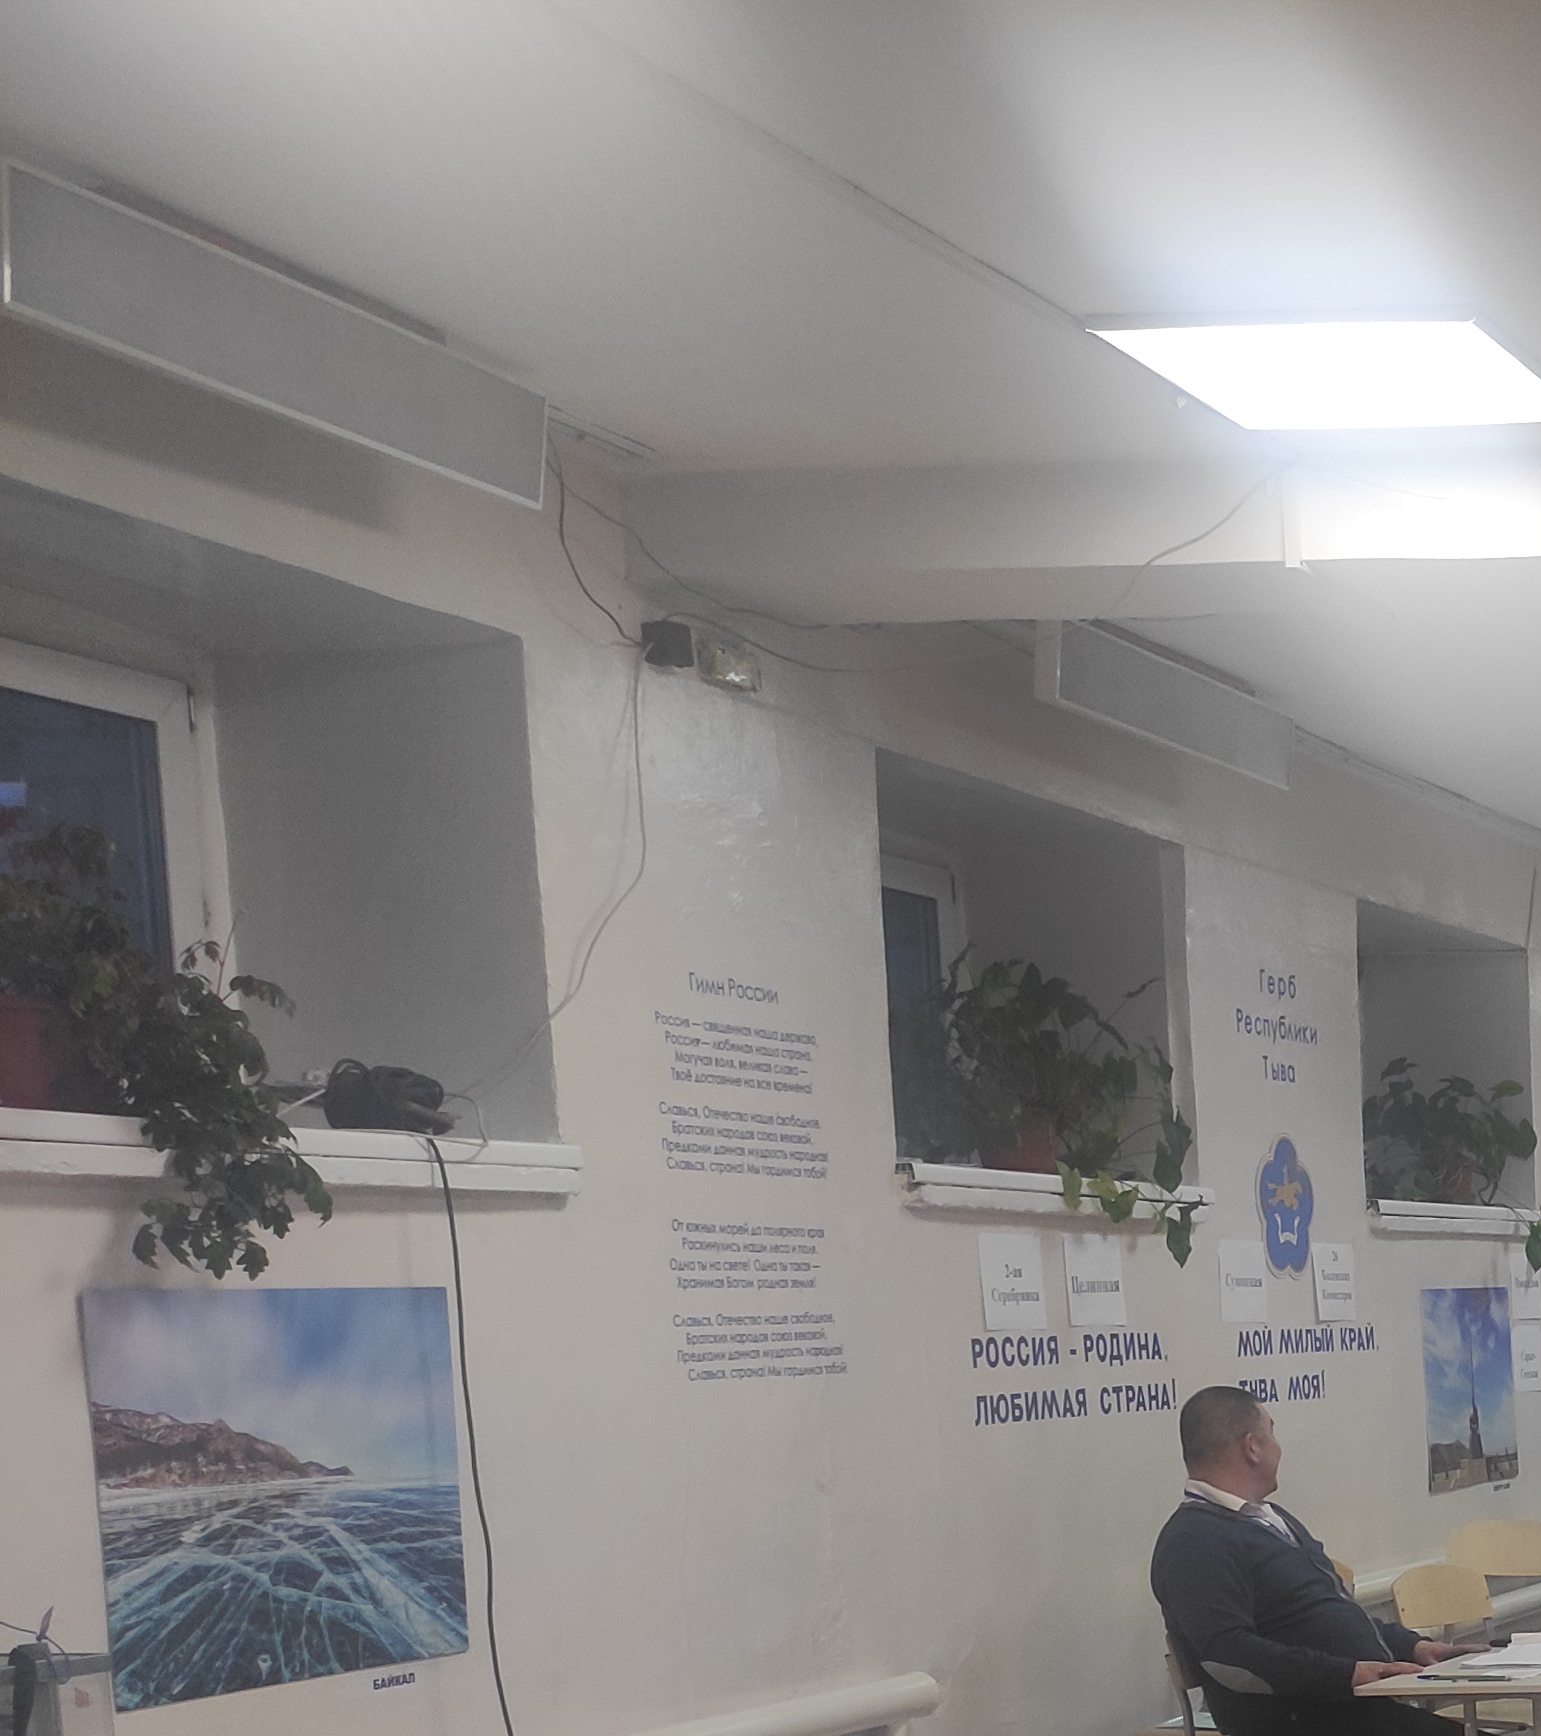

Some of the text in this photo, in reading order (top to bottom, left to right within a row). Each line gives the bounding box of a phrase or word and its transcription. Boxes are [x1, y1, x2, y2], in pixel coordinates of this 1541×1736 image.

[689, 972, 779, 1004] Гимн России
[655, 1011, 690, 1028] Россия
[1236, 1008, 1318, 1045] Республики
[665, 1030, 700, 1047] Россия
[1262, 1055, 1296, 1083] Тыва
[671, 1218, 684, 1232] От
[1071, 1276, 1120, 1295] Целинная
[971, 1335, 1060, 1369] РОССИЯ
[1083, 1332, 1168, 1367] РОДИНА,
[1238, 1322, 1379, 1358] МОЙ МИЛЫЙ КРАЙ,
[1288, 1369, 1326, 1401] МОЯ!
[974, 1378, 1177, 1426] ЛЮБИМАЯ СТРАНА!
[373, 1672, 415, 1690] БАЙКАЛ
